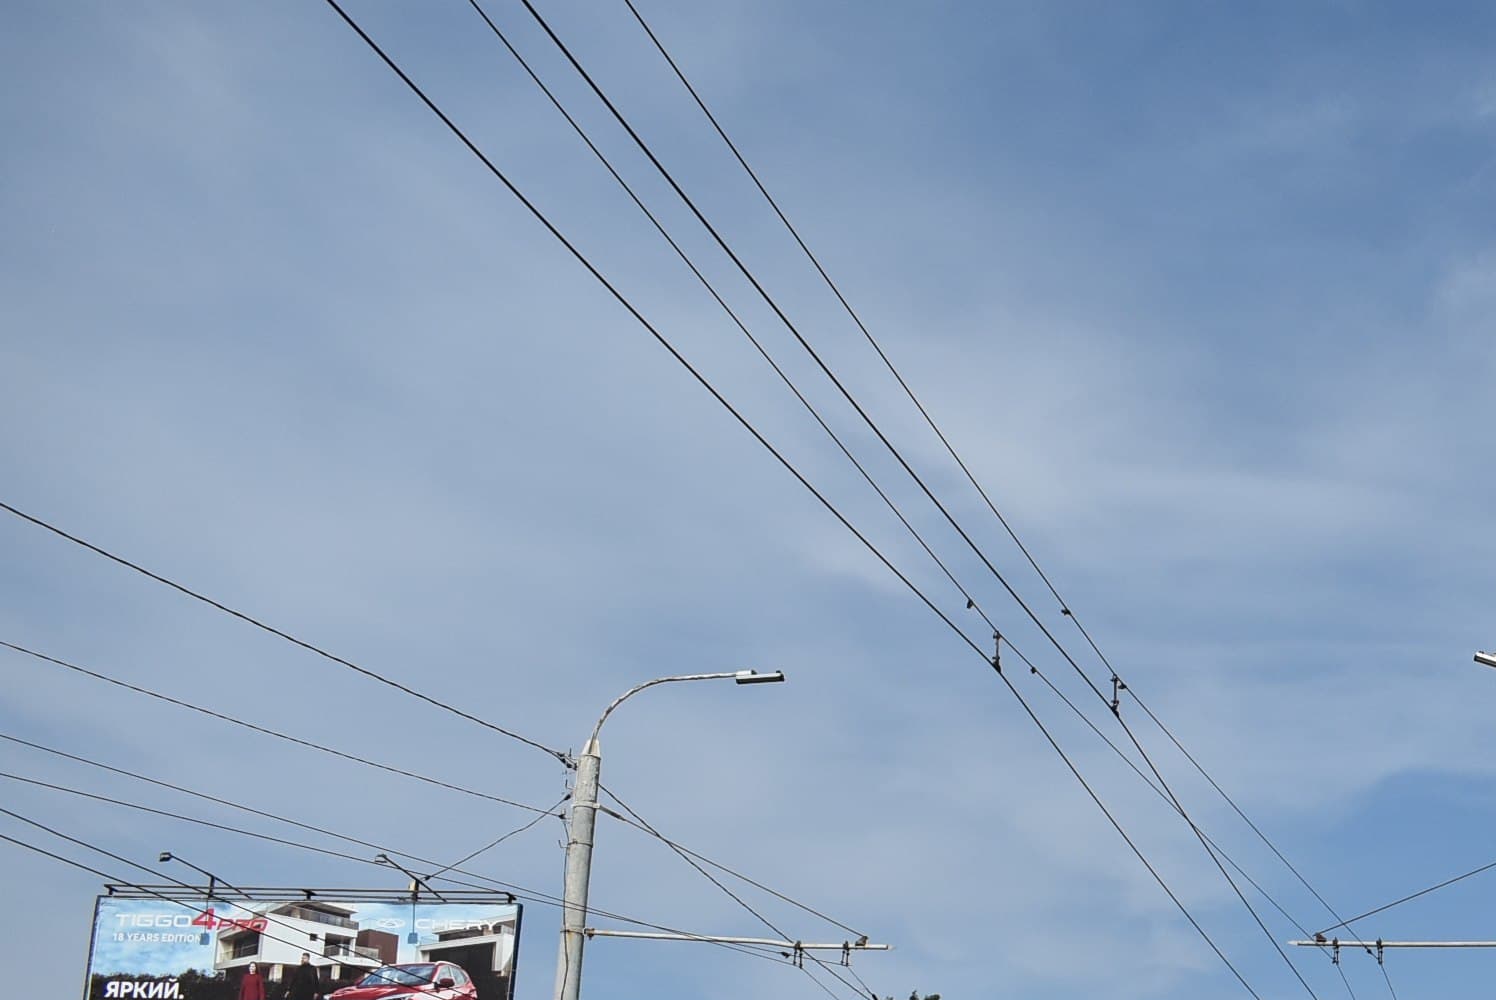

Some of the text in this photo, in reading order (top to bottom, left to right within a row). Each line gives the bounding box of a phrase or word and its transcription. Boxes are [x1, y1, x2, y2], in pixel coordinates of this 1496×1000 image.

[113, 933, 202, 944] 18 YEARS EDITION
[104, 978, 185, 1000] ЯРКИЙ.
